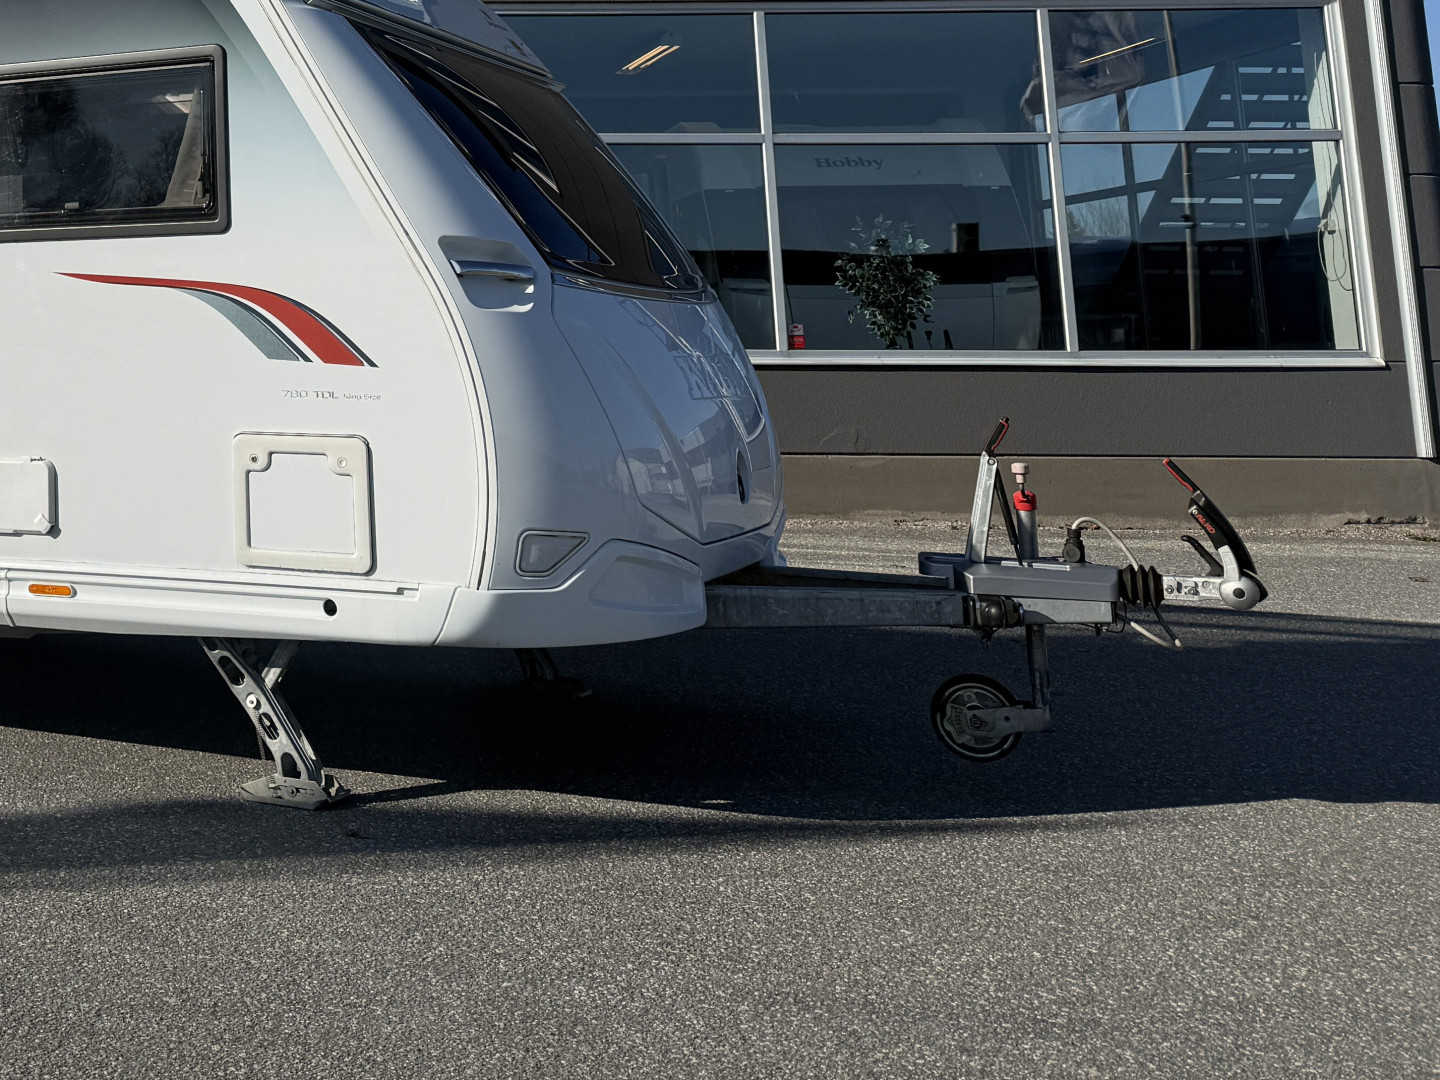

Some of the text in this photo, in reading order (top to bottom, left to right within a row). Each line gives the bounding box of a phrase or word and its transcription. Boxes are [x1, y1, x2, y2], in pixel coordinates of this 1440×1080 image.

[814, 156, 884, 170] Hobby
[281, 389, 308, 399] 780
[313, 390, 339, 400] TDL
